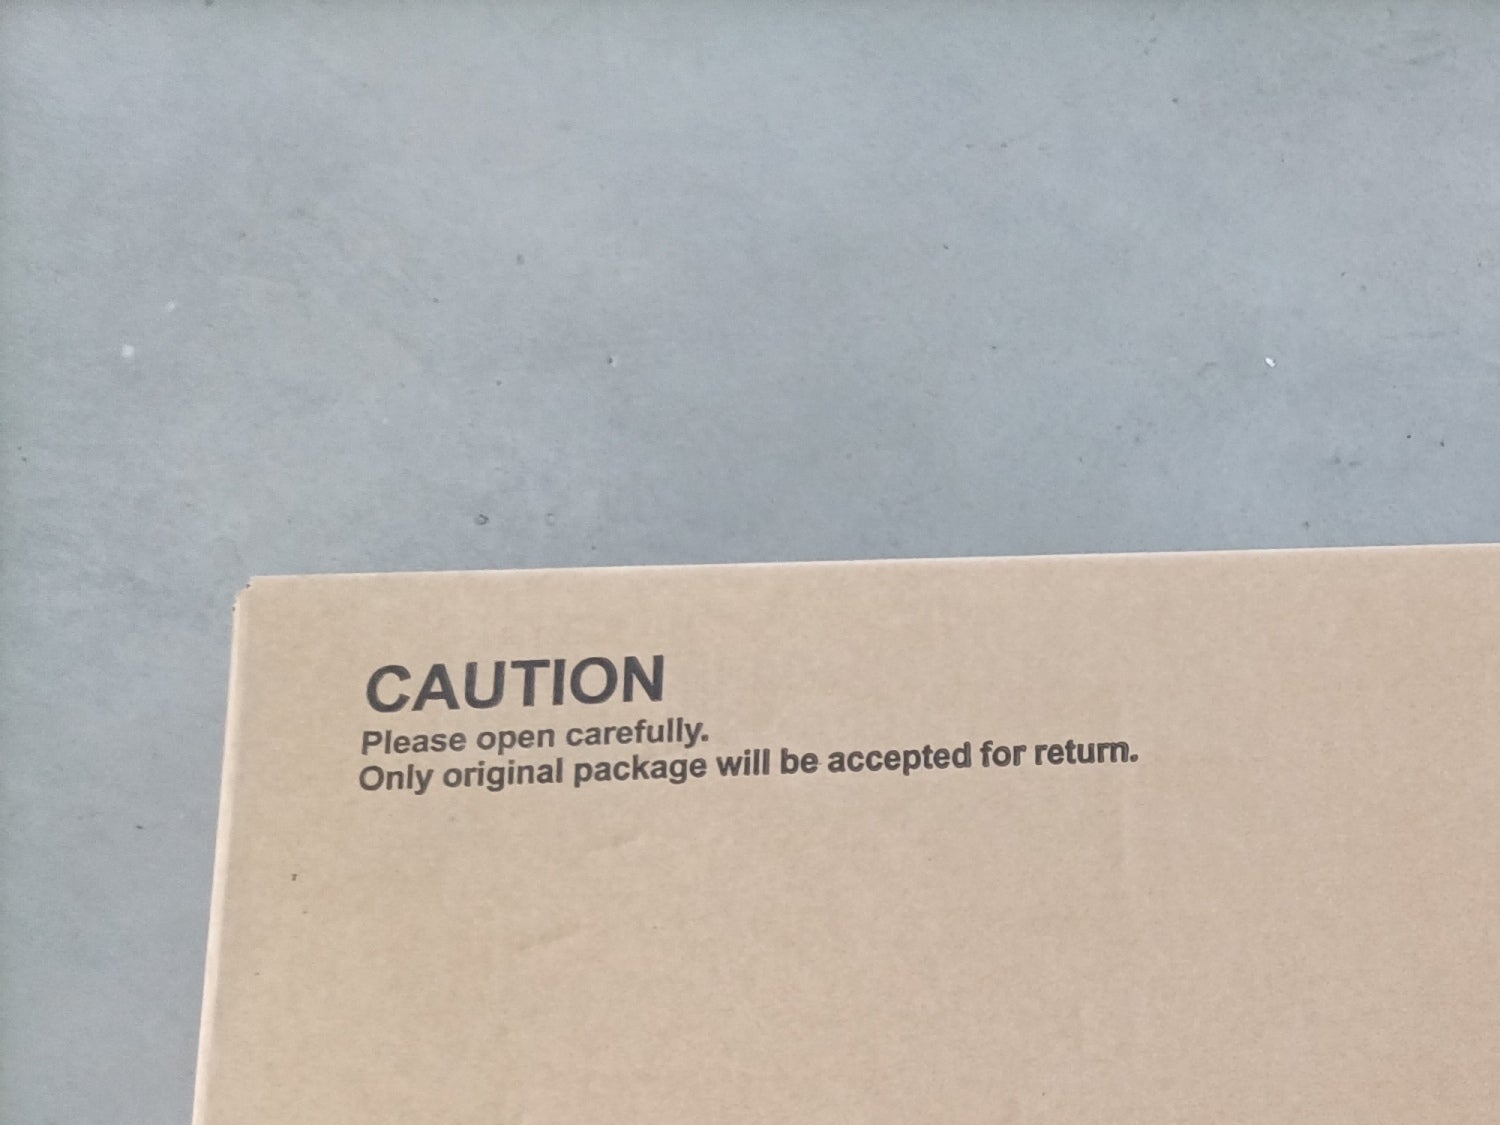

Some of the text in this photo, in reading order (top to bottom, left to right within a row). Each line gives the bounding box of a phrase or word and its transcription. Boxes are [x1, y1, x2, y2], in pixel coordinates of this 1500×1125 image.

[366, 655, 664, 712] CAUTION
[362, 717, 709, 755] Please open carefully.
[359, 739, 1138, 795] Only original package will be accepted for return.
